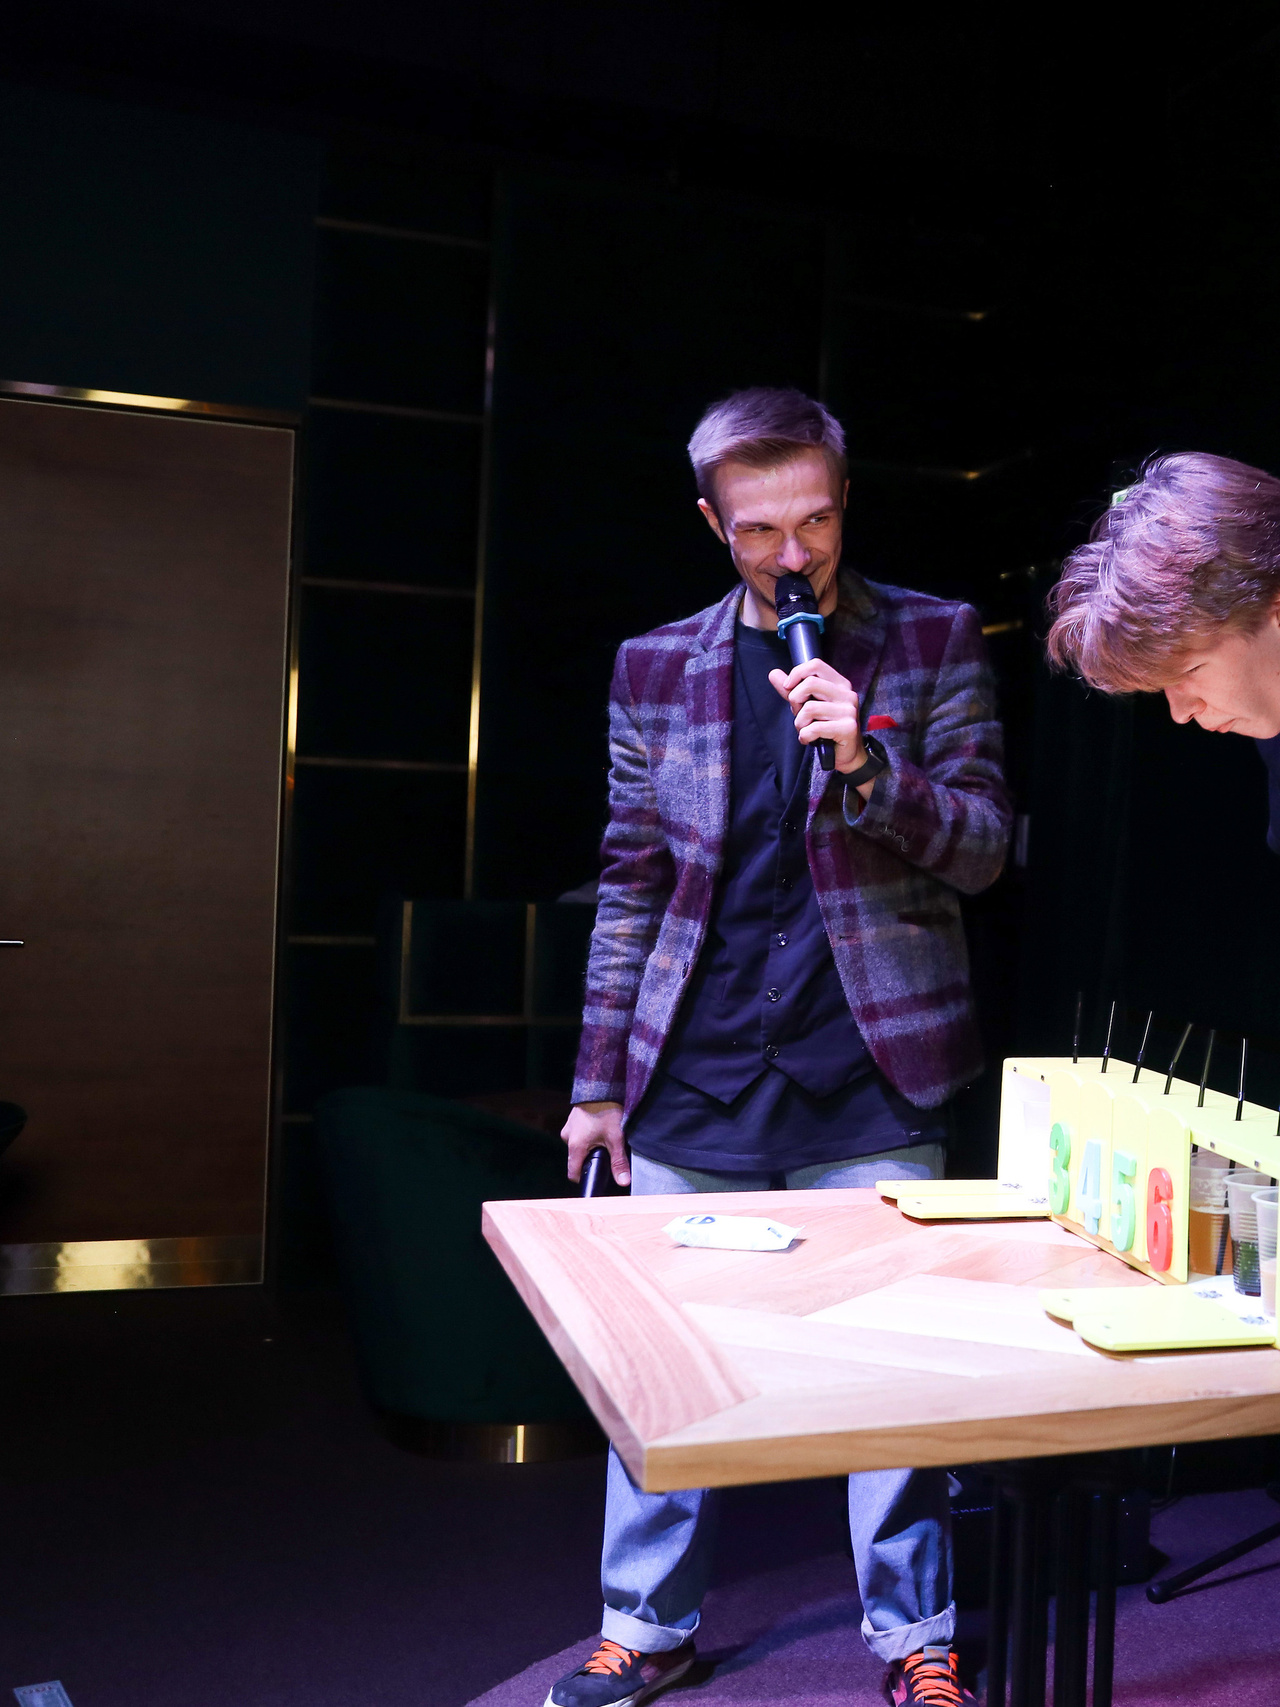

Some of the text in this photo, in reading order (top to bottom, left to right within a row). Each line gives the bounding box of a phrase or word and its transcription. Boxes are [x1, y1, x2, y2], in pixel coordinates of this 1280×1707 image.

[1048, 1122, 1174, 1272] 3 4 5 6
